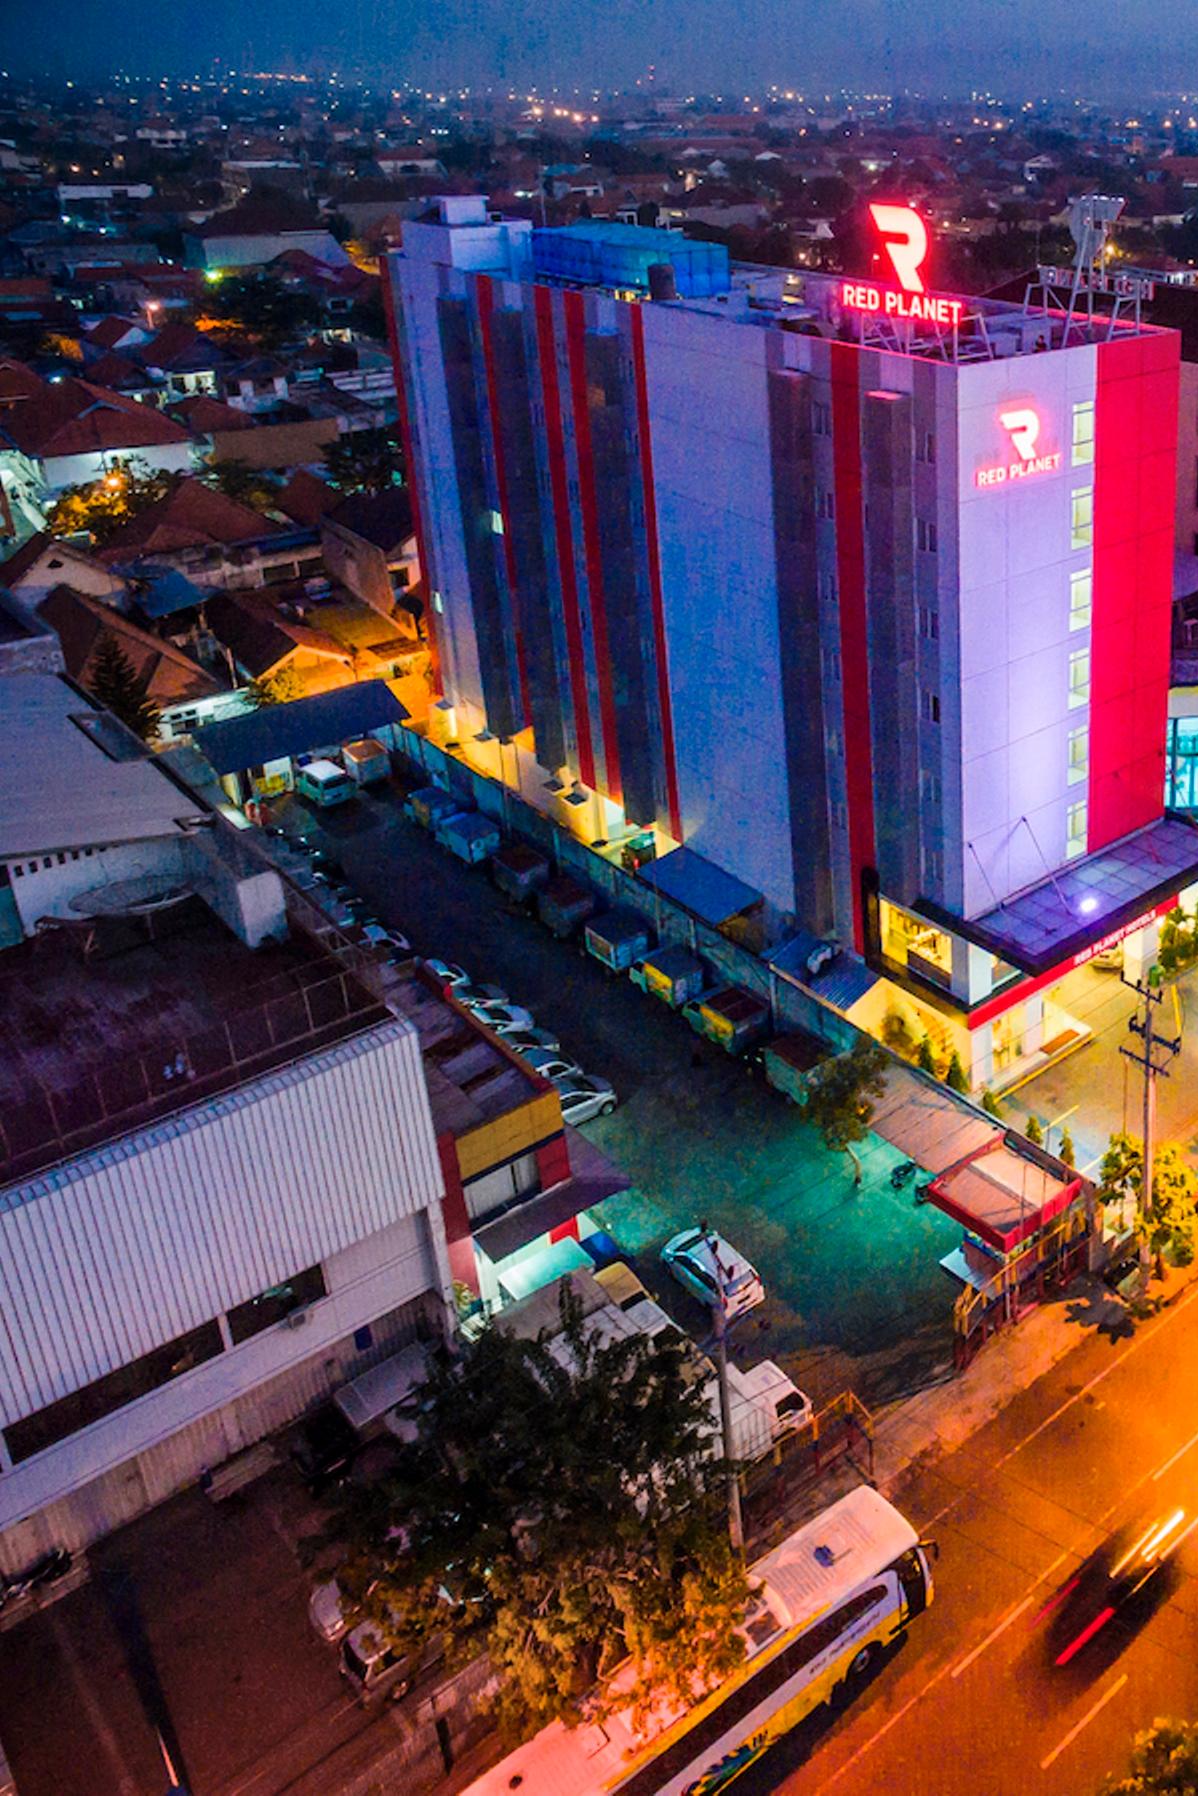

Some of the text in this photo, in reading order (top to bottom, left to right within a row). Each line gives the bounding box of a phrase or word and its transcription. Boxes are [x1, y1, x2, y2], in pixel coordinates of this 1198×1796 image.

[869, 204, 927, 292] R
[843, 284, 962, 324] RED PLANET
[1000, 409, 1040, 460] R
[978, 453, 1061, 486] RED PLANET
